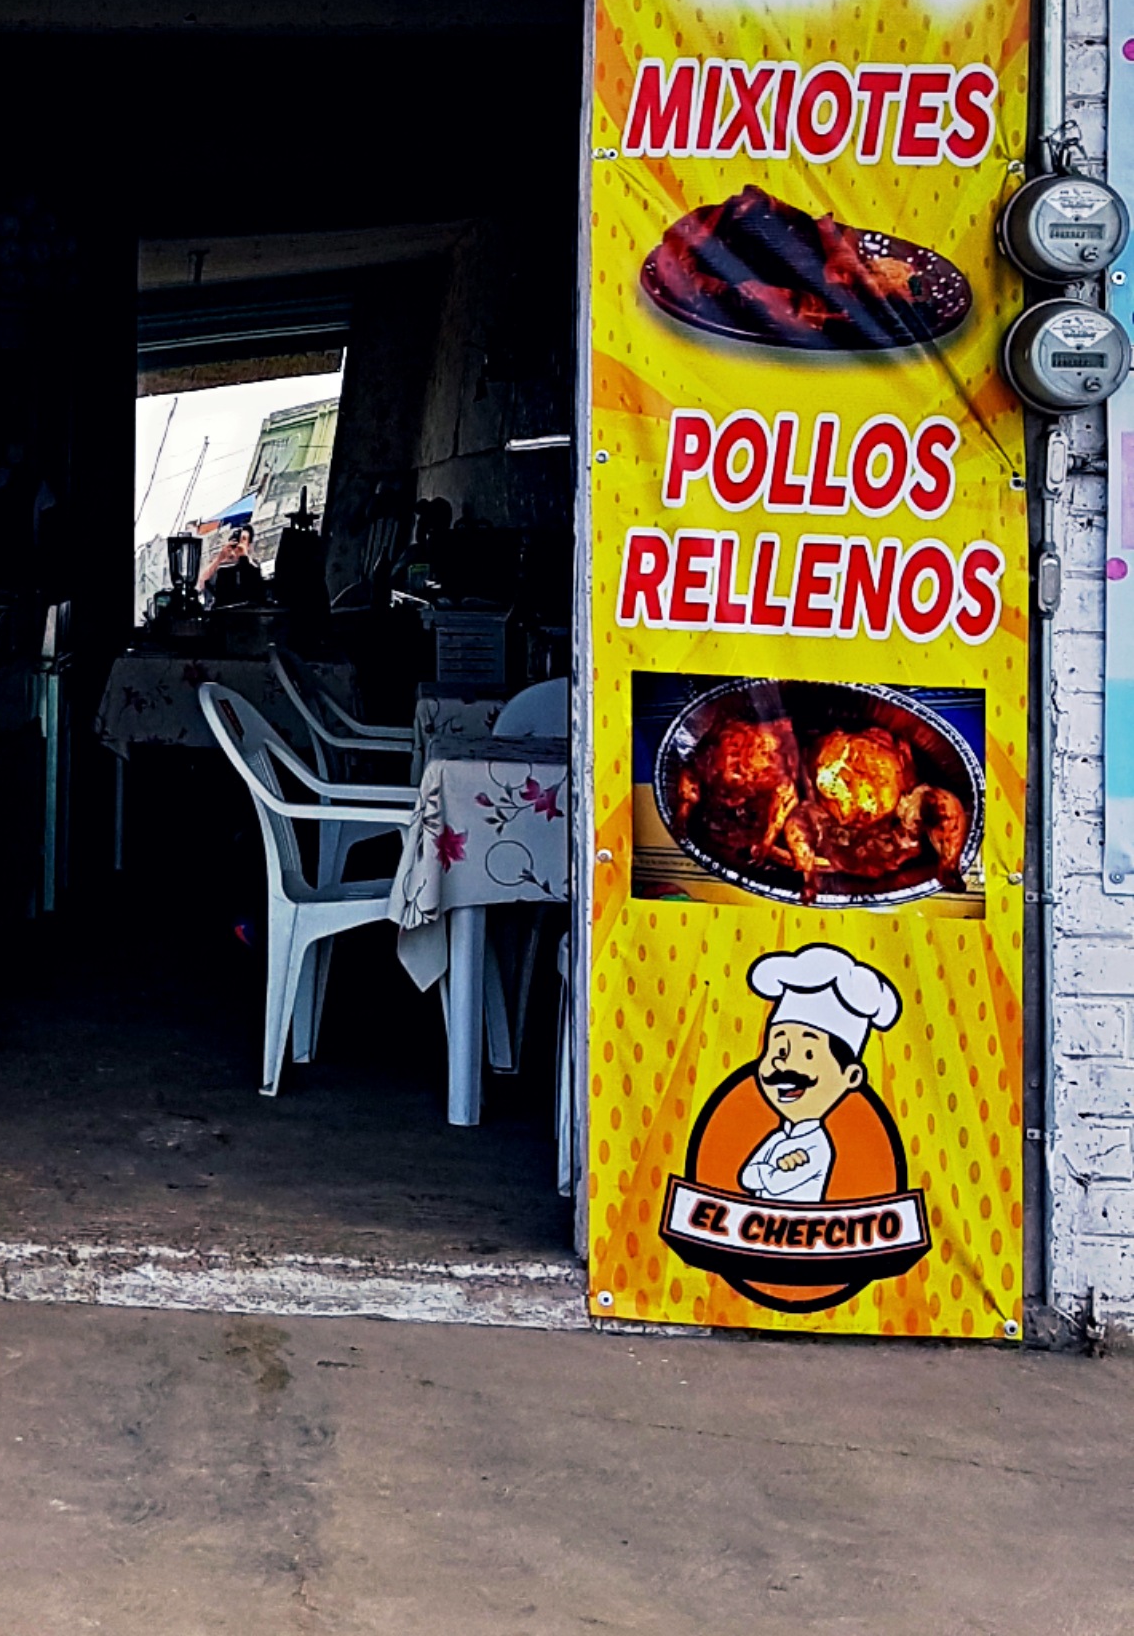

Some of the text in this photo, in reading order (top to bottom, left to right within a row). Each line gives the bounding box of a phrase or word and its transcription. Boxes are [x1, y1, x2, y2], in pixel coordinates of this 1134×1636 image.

[623, 63, 997, 163] MIXIOTES
[664, 413, 959, 516] POLLOS
[618, 532, 1004, 641] RELLENOS
[689, 1199, 903, 1248] EL CHEFCITO
